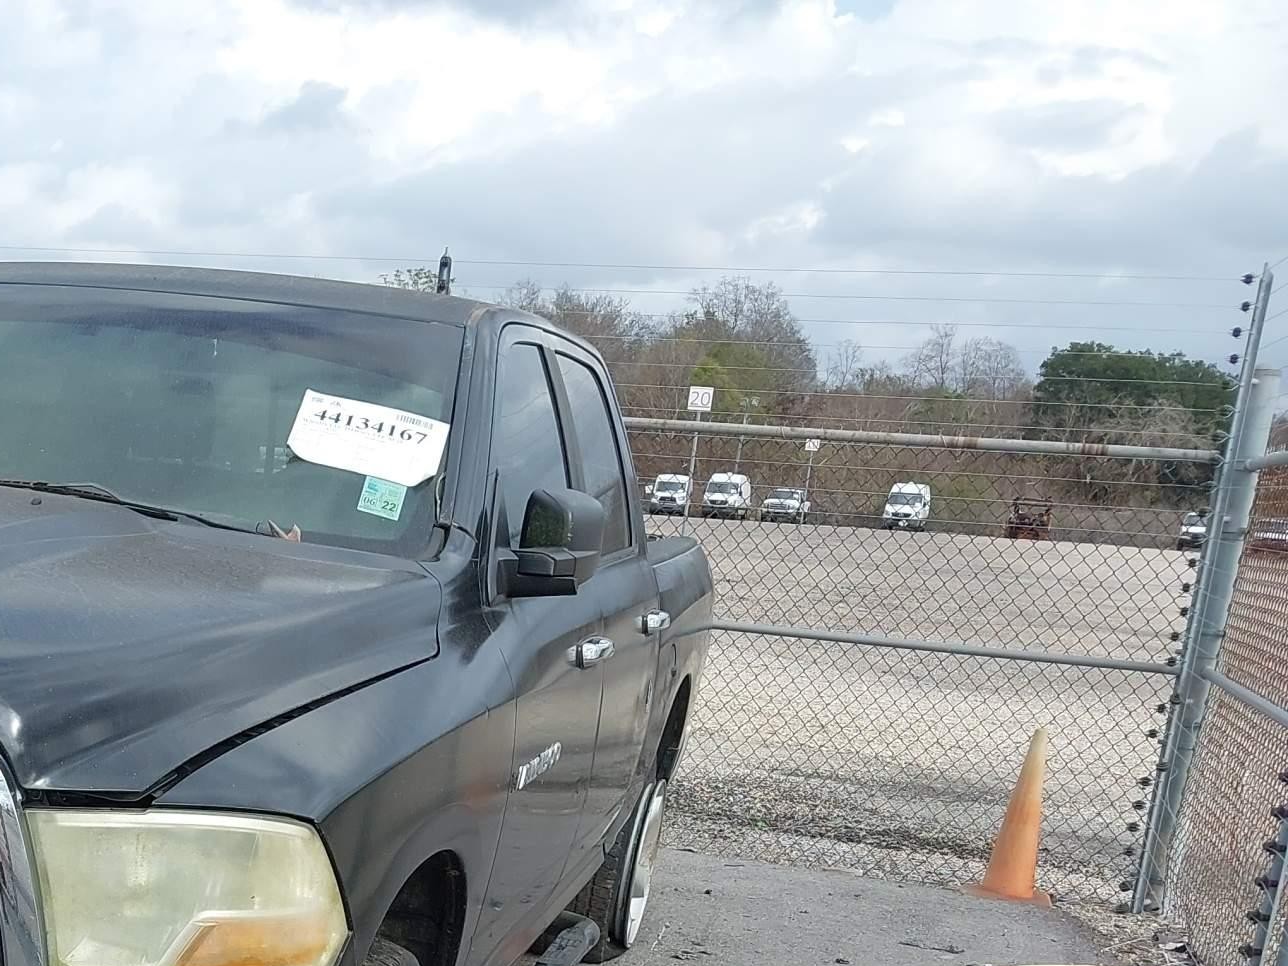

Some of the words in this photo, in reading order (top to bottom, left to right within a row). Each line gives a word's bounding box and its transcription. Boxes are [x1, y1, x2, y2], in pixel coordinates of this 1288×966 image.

[690, 391, 711, 406] 20
[314, 409, 428, 445] 44134167
[382, 500, 397, 512] 22
